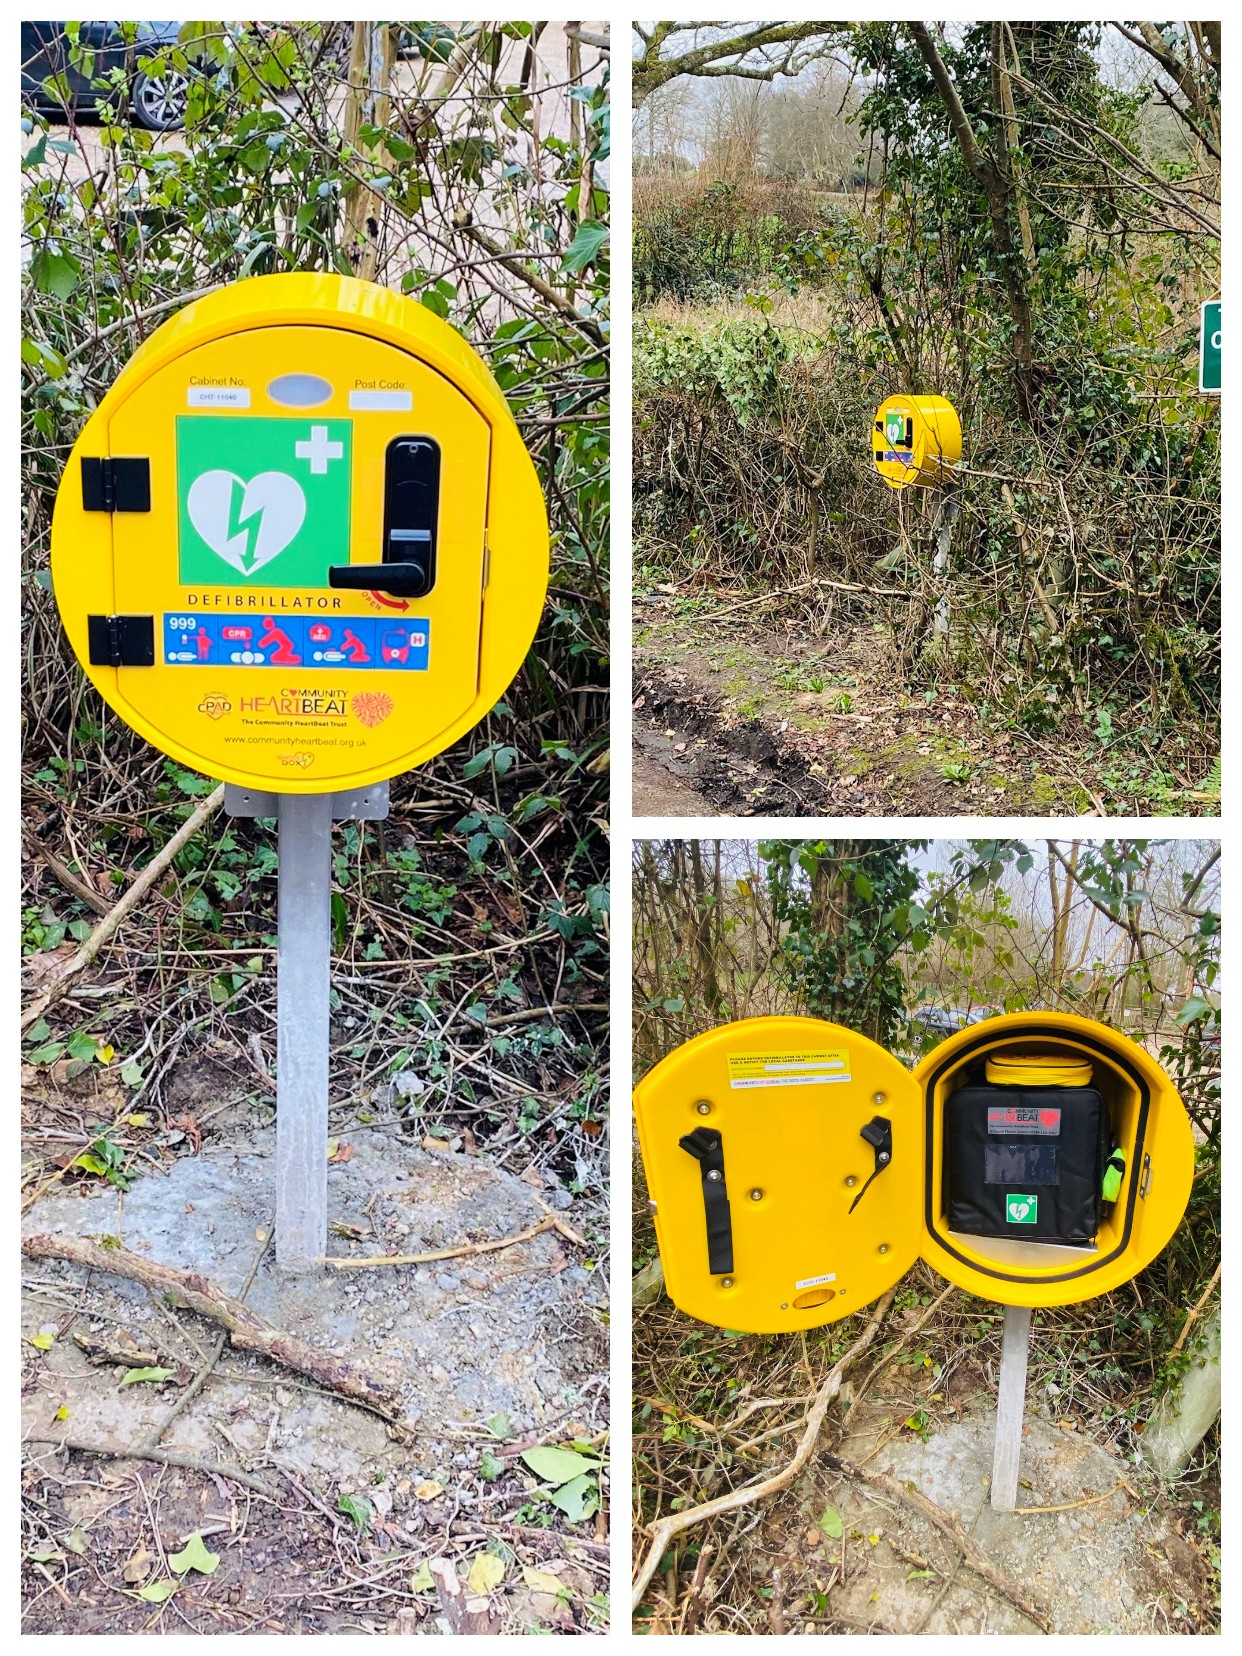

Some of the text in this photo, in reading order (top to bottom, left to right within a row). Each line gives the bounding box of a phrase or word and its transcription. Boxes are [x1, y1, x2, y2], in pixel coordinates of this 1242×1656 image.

[189, 376, 247, 387] Cabinet No:
[354, 379, 408, 390] Post Code:
[187, 594, 343, 609] DEFIBRILLATOR
[361, 590, 383, 612] OPEN
[169, 617, 197, 630] 999
[227, 629, 247, 638] CPR
[240, 696, 348, 715] HEARTBEAT
[255, 719, 294, 728] Community
[223, 736, 367, 748] www.communityheartbeat.org.uk
